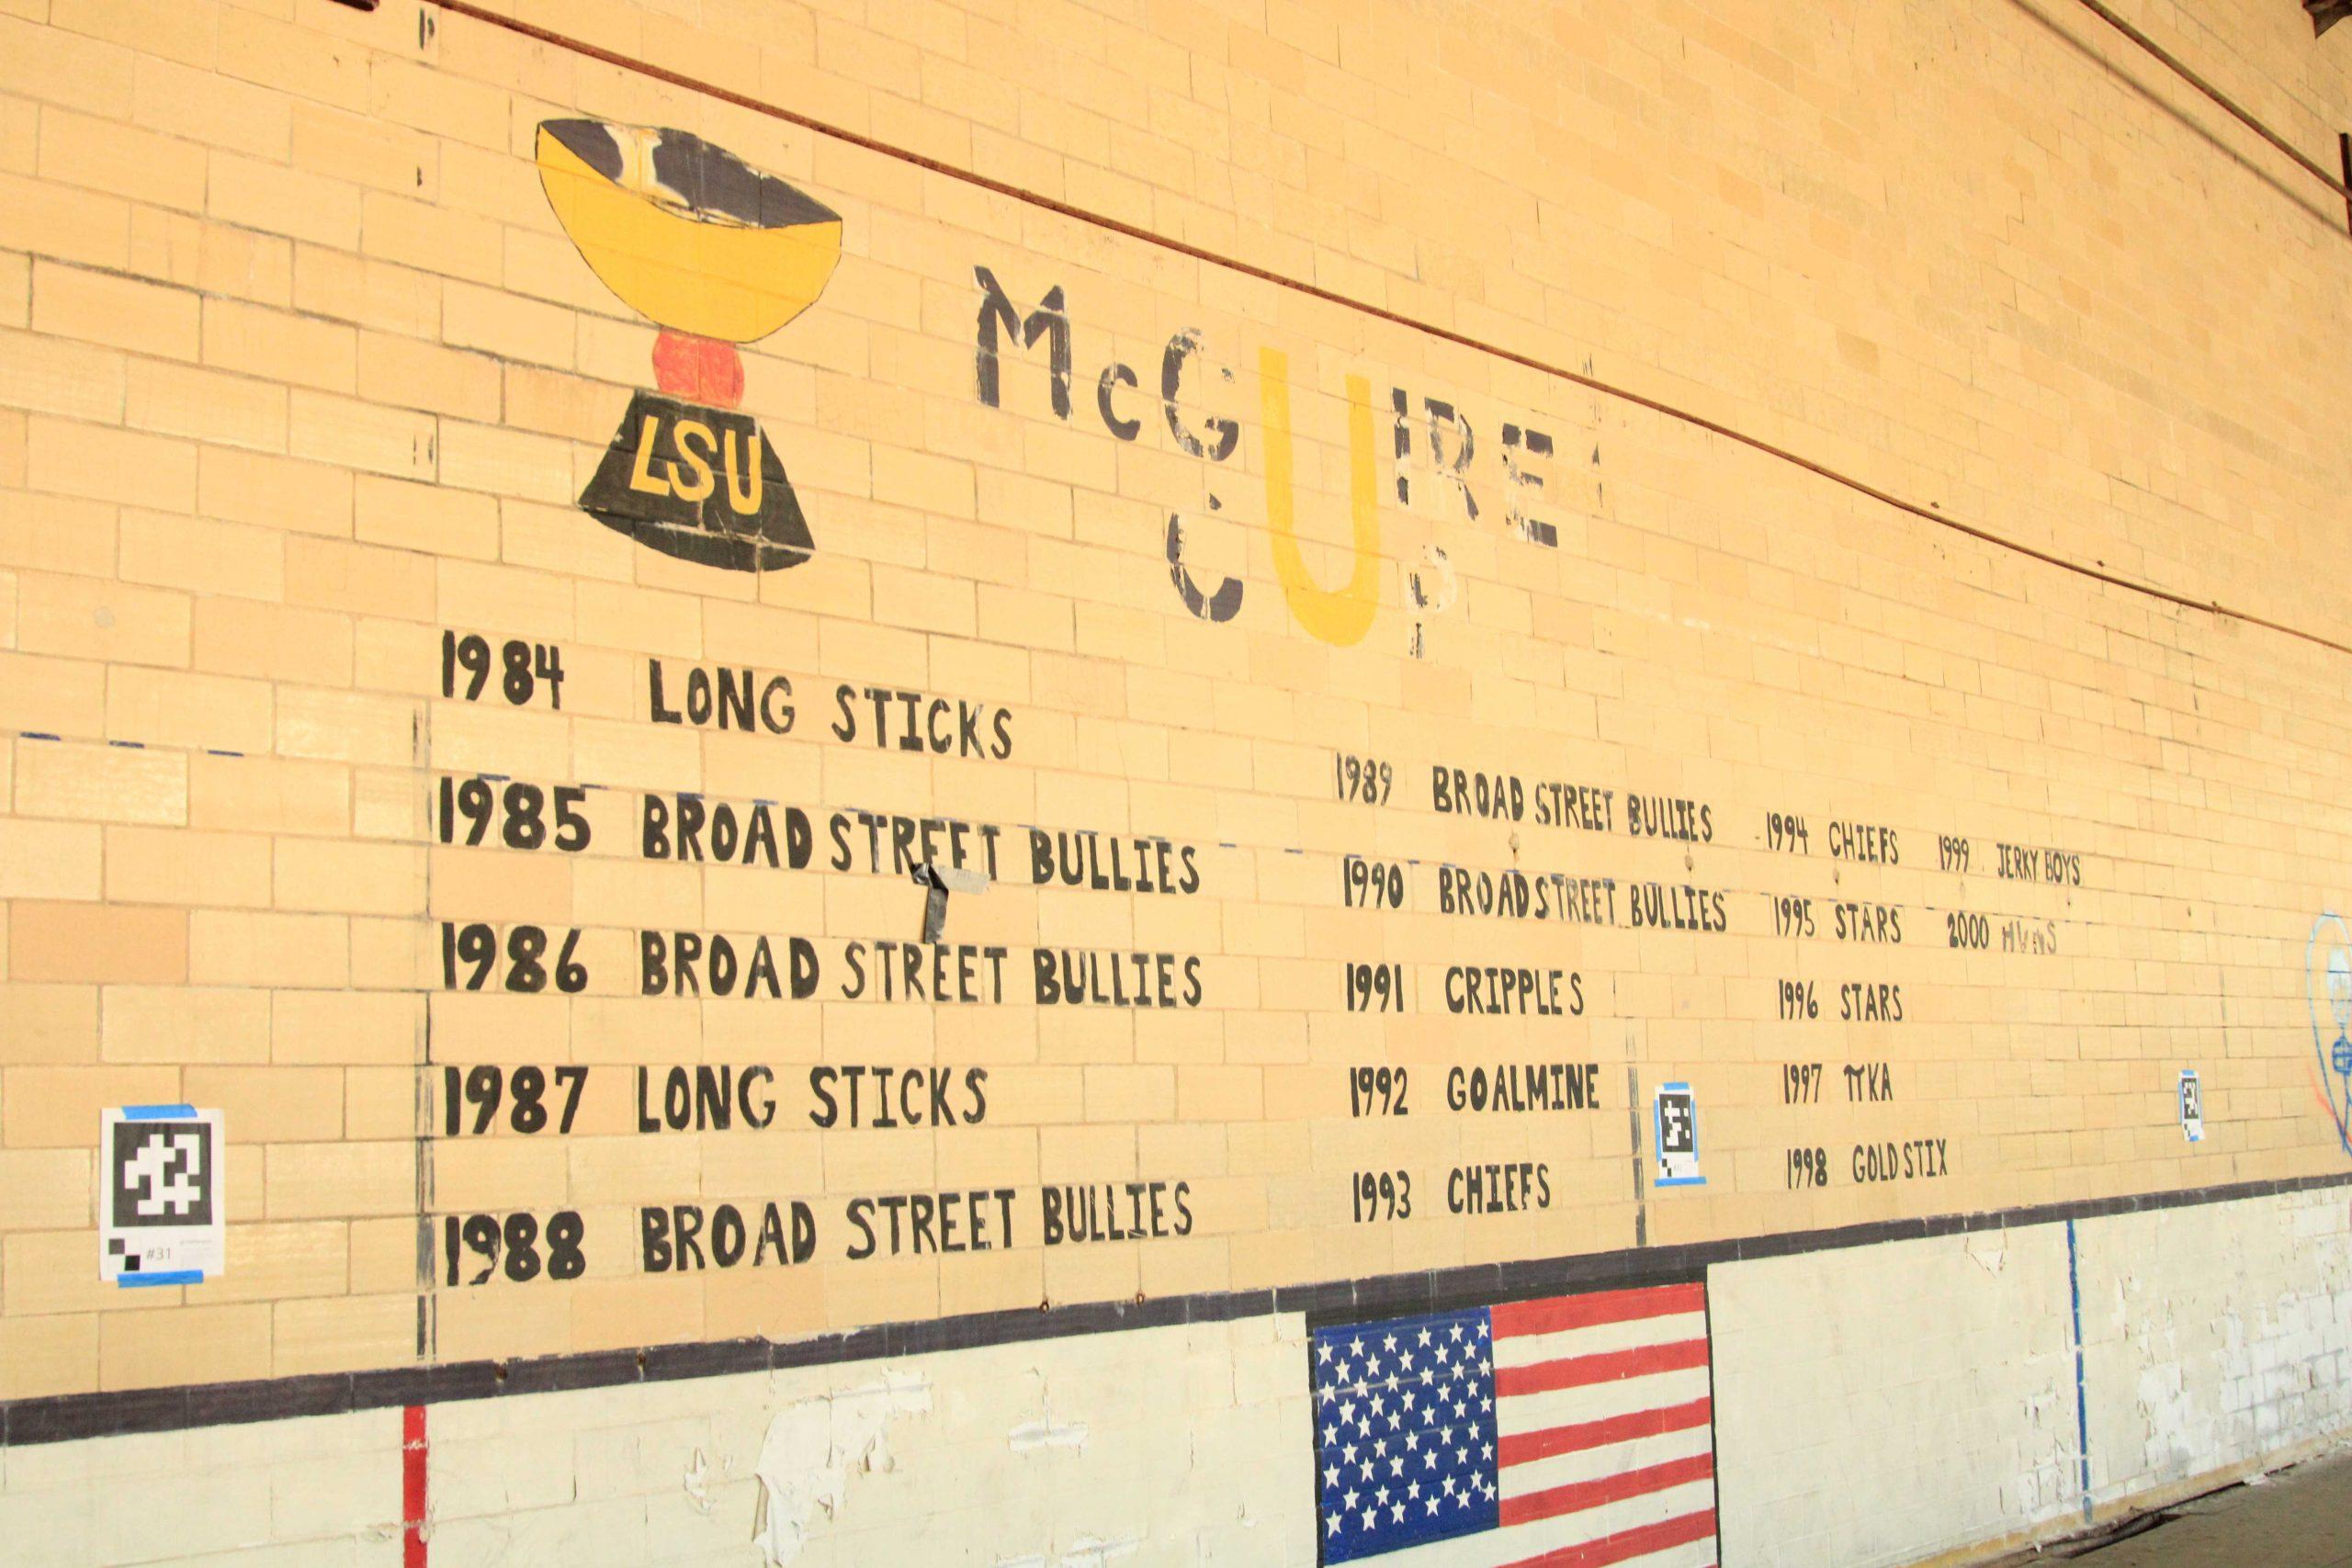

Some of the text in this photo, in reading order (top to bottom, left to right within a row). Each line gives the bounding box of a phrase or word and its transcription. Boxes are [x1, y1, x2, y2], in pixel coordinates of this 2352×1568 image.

[629, 412, 763, 516] LSU
[441, 629, 1012, 761] 1984 LONG STICKS
[1336, 752, 1713, 843] 1989 BROAD STREET BULLIES
[439, 773, 1200, 895] 1985 BROAD STREET BULLIES
[1766, 812, 1899, 865] 1994 CHIEFS
[1939, 835, 2081, 886] 1999 JERKY BOYS
[1343, 854, 1404, 909] 1990
[1439, 867, 1530, 919] BROAD
[1630, 883, 1726, 932] BULLIES
[1774, 897, 1902, 943] 1995 STARS
[1947, 910, 1990, 950] 2000
[441, 921, 1202, 1009] 1986 BROAD STREET BULLIES
[1346, 963, 1584, 1016] 1991 CRIPPLES
[1778, 979, 1903, 1021] 1996 STARS
[444, 1064, 989, 1138] 1987 LONG STICKS
[1350, 1063, 1600, 1118] 1992 GOALMINE
[1783, 1063, 1823, 1104] 1997
[1787, 1138, 1948, 1190] 1998 GOLD STIX
[1352, 1162, 1551, 1224] 1993 CHIEFS
[147, 1247, 172, 1261] #31
[445, 1180, 1193, 1287] 1988 BROAD STREET BULLIES
